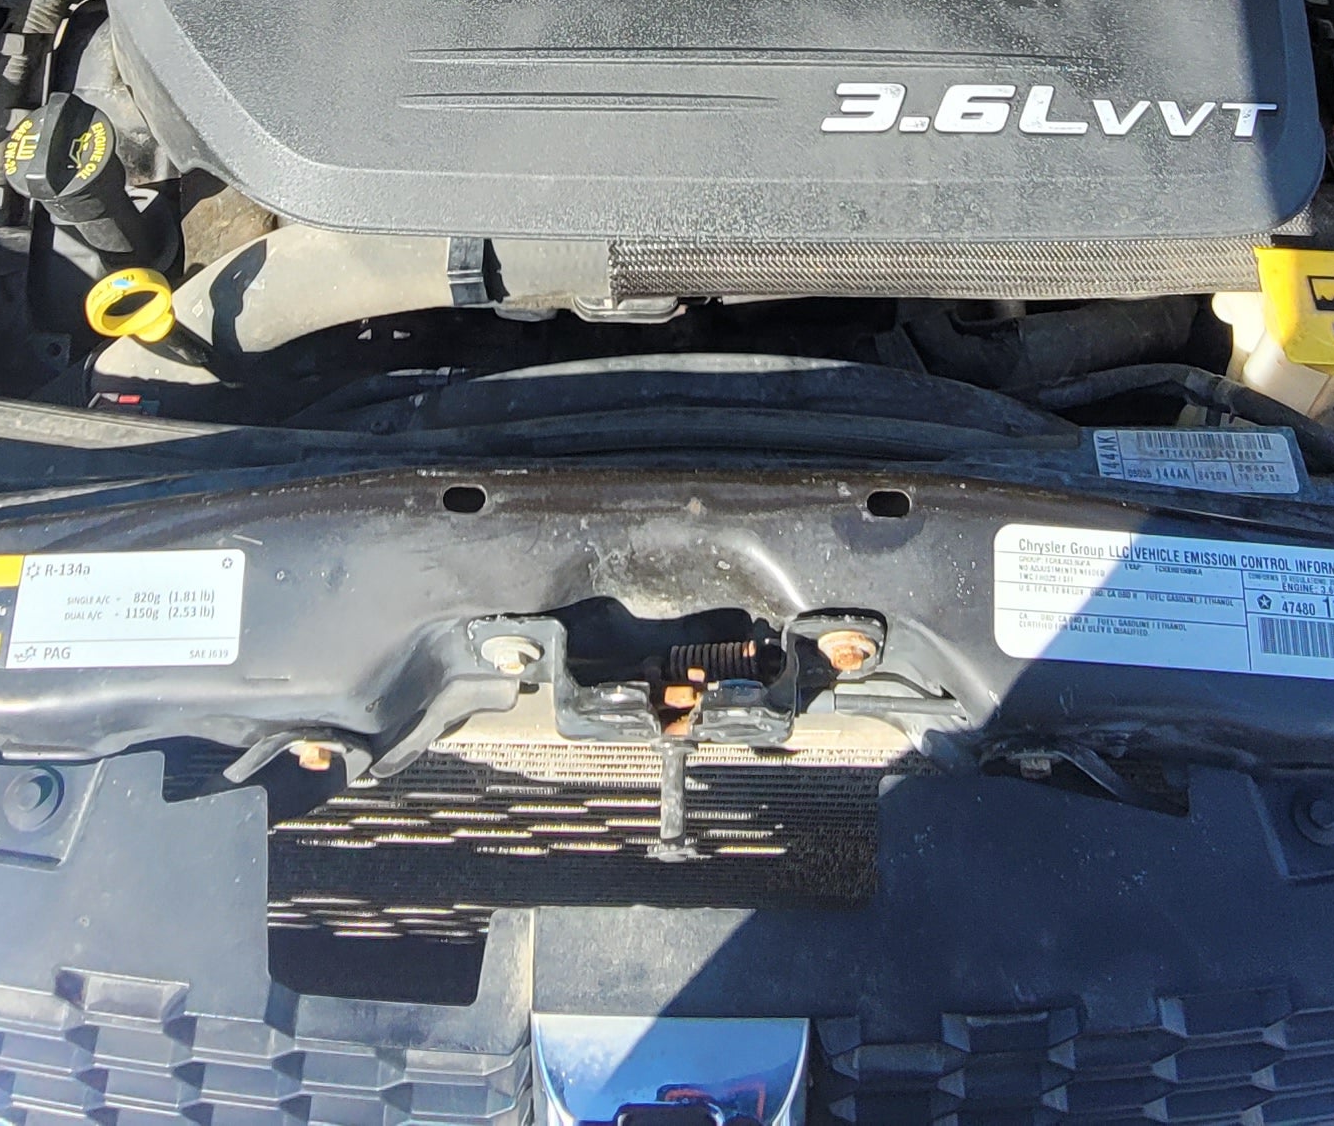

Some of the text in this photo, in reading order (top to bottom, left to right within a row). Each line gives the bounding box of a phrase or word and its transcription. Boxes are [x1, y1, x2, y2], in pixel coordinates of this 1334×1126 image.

[820, 82, 1278, 138] 3.6L VVT
[75, 121, 107, 180] ENGINE OIL
[1019, 538, 1066, 555] Chrysler
[1070, 542, 1104, 557] Group
[1109, 544, 1130, 559] LLC
[1134, 546, 1180, 563] VEHICLE
[1184, 550, 1237, 568] EMISSION
[1241, 555, 1291, 572] CONTROL
[44, 563, 91, 576] R-134a
[66, 589, 215, 605] SINGLE A/C 820g (1.81 lb)
[64, 605, 215, 621] DUAL A/C 1150g (2.53 lb)
[1282, 600, 1316, 616] 47480
[43, 647, 72, 660] PAG
[189, 650, 206, 659] SAE
